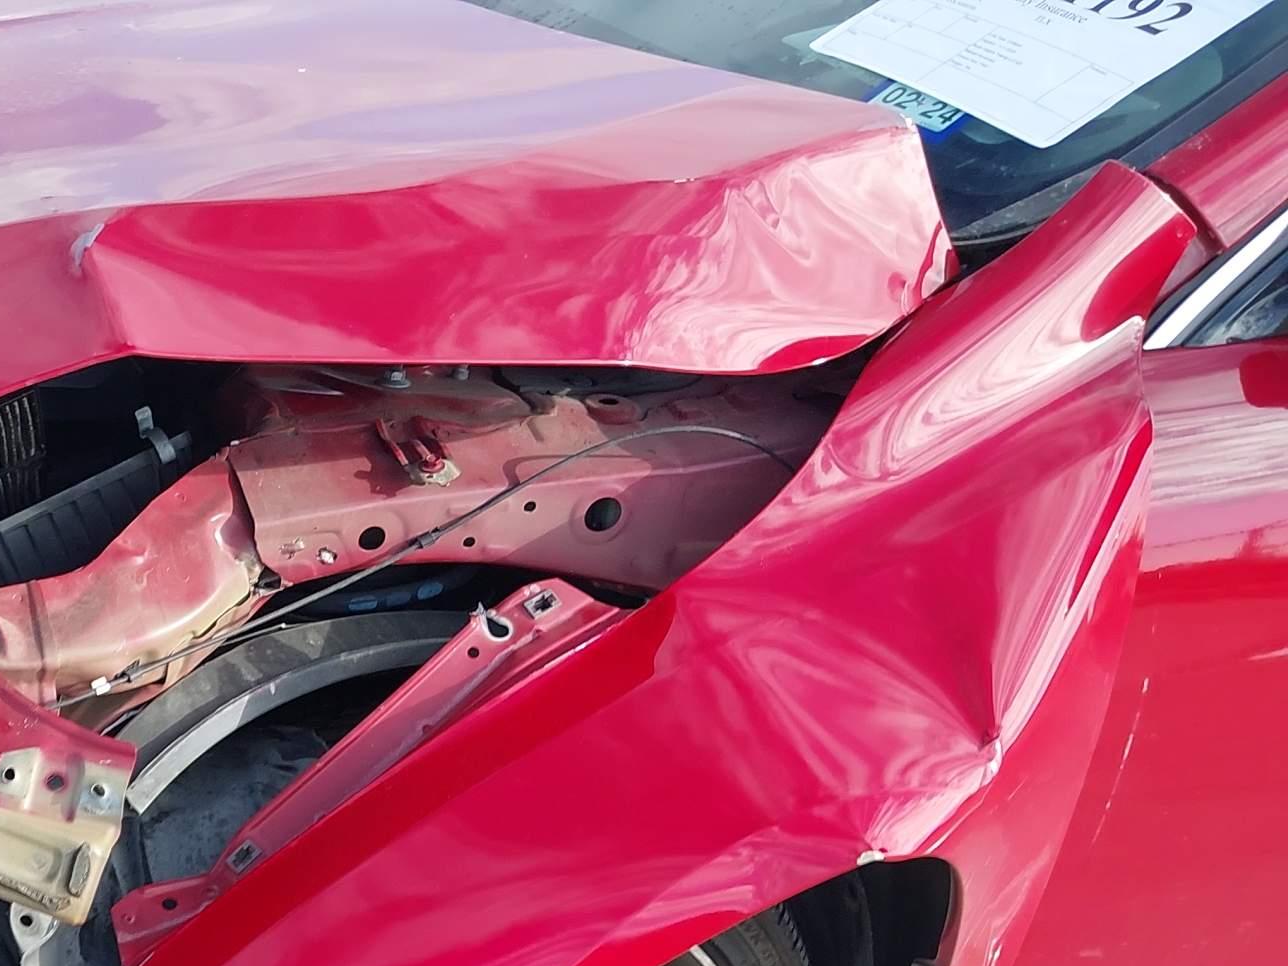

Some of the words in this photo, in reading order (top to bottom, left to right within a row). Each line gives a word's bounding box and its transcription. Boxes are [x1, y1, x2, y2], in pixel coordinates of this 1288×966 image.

[1033, 0, 1088, 24] Insurance
[881, 87, 922, 109] 02
[918, 101, 961, 125] 24
